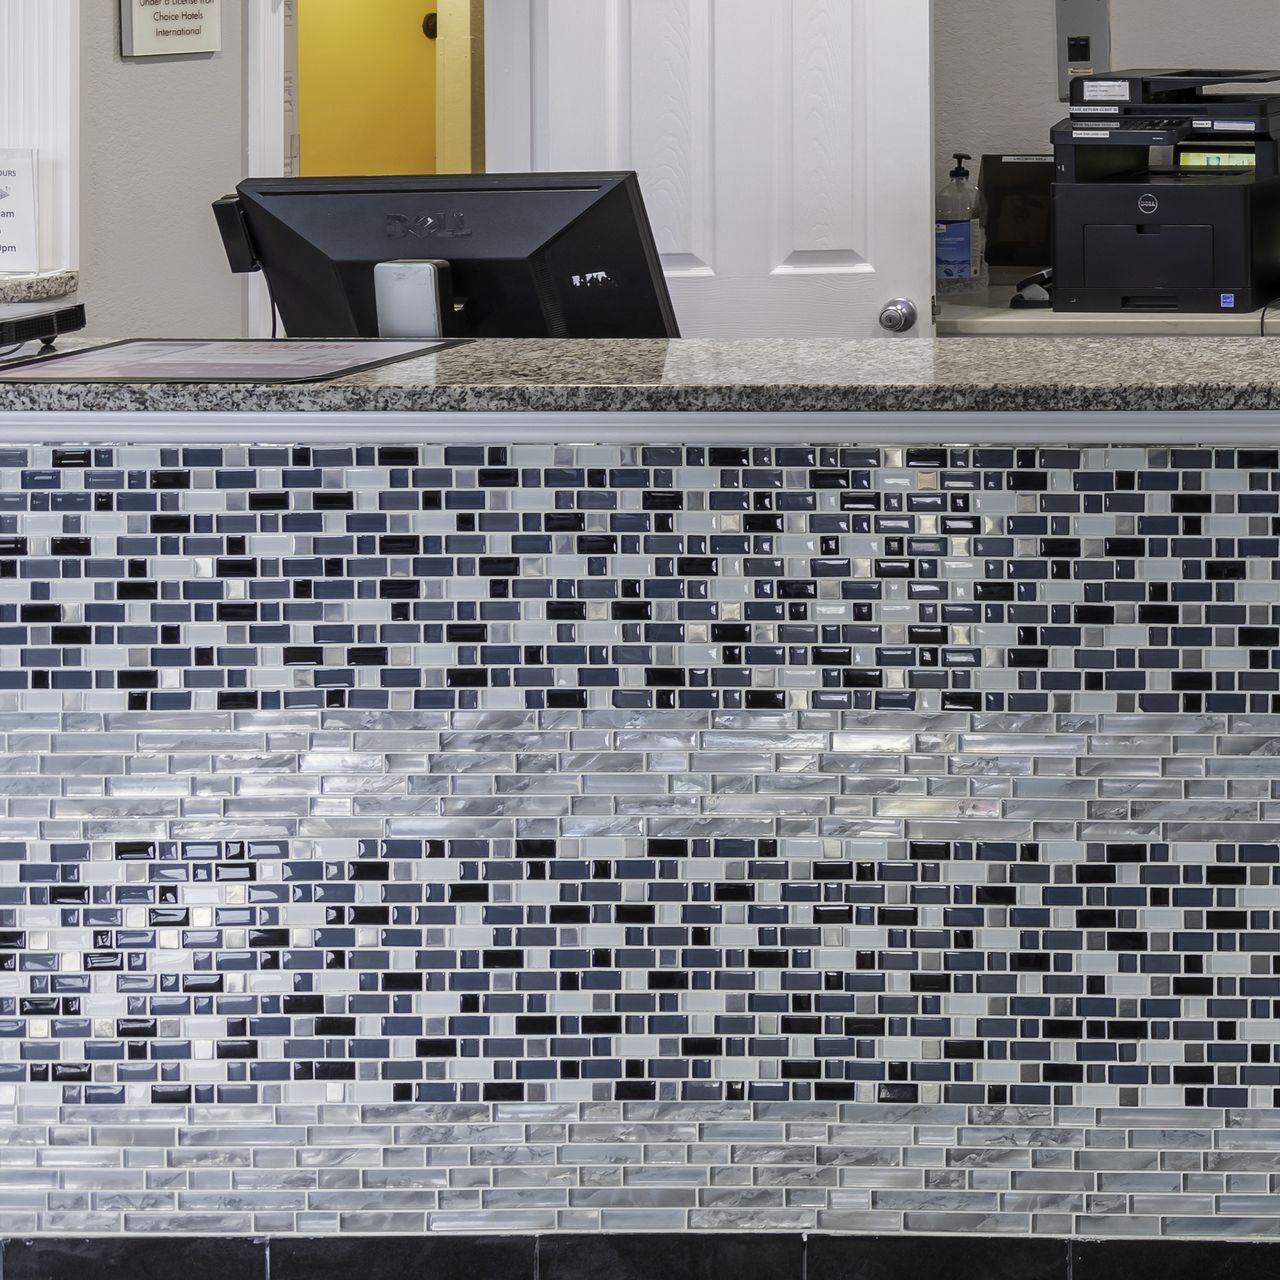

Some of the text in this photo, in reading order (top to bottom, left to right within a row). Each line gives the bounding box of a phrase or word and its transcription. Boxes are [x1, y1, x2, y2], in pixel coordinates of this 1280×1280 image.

[153, 10, 203, 21] Choice Hotels
[156, 25, 201, 36] International
[1, 210, 15, 218] am
[386, 213, 472, 238] DELL
